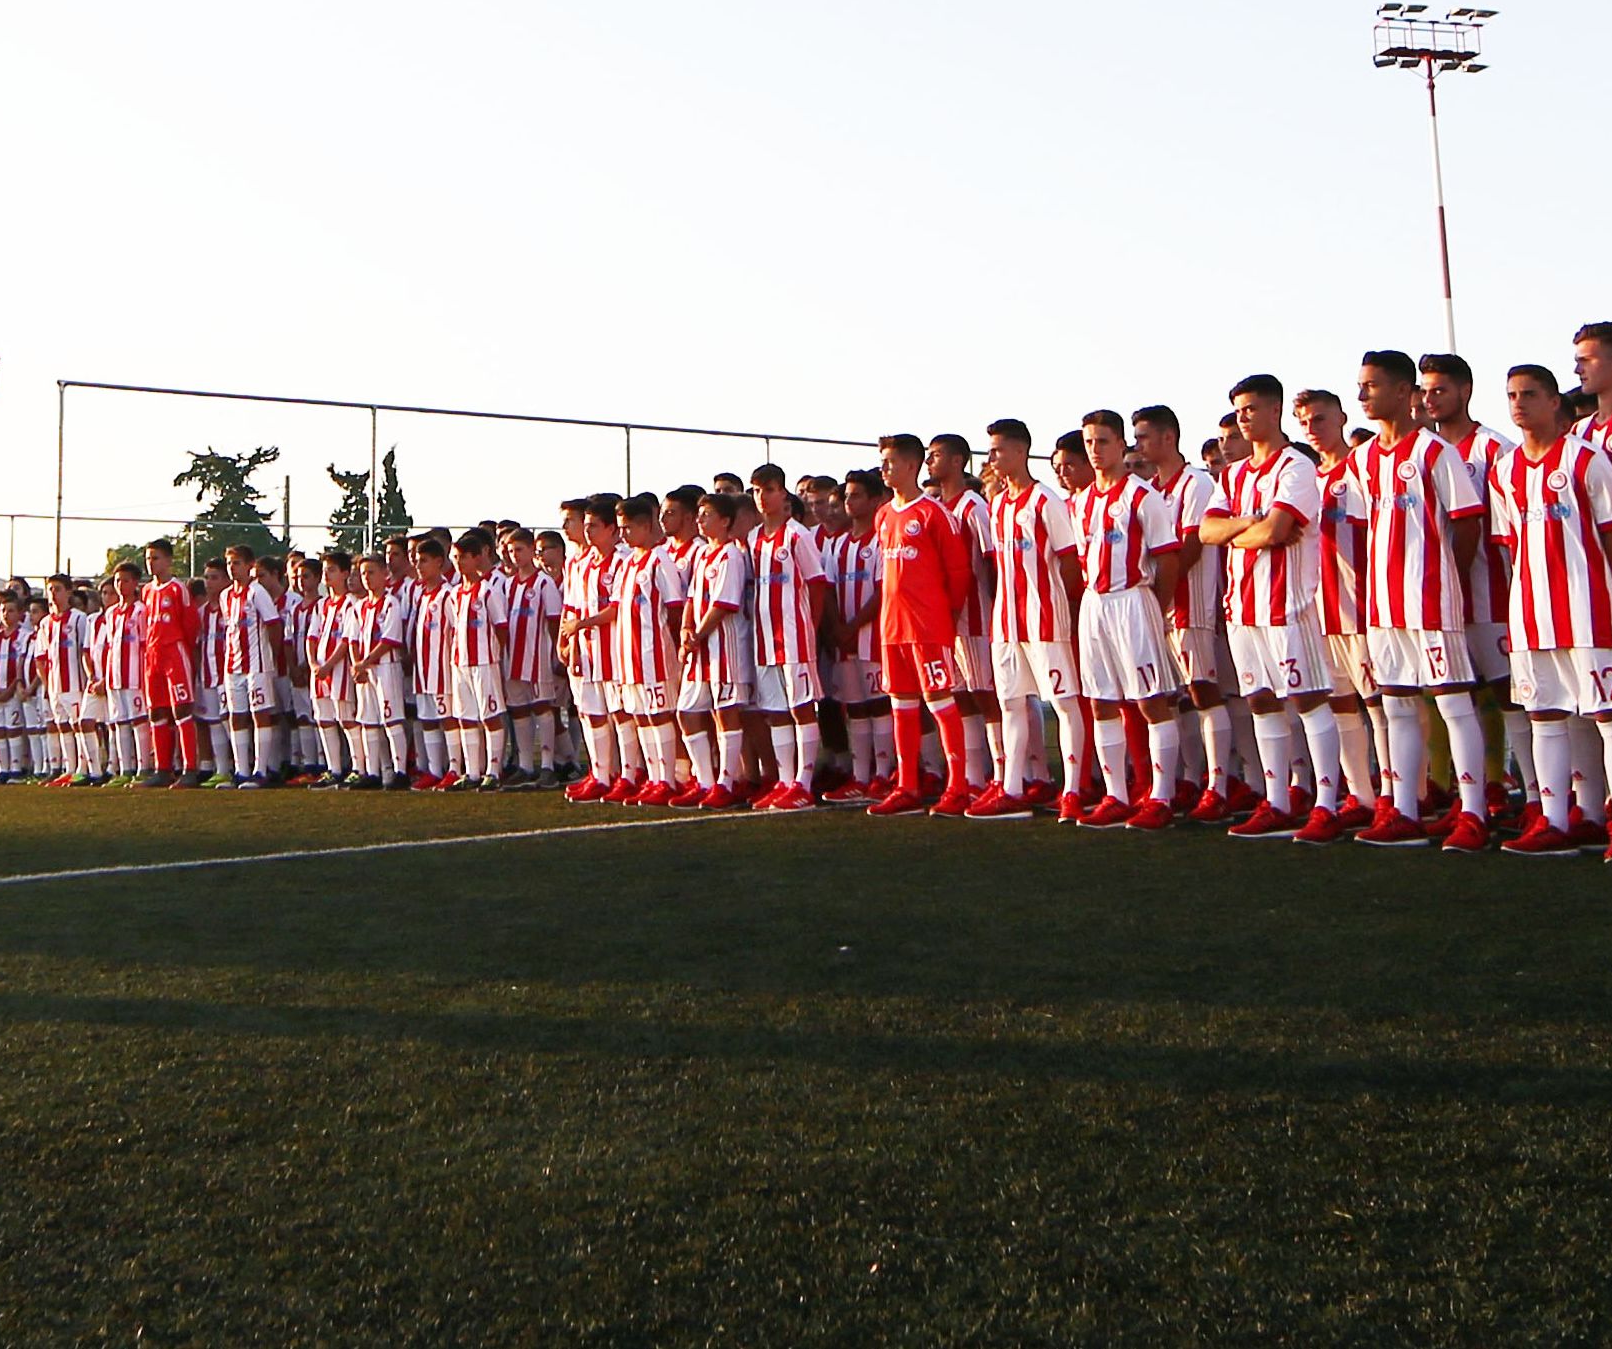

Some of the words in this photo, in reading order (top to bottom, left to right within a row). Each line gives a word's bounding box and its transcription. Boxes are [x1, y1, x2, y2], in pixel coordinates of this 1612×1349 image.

[923, 660, 947, 687] 15
[1425, 647, 1448, 679] 13
[799, 672, 809, 696] 7
[1049, 669, 1066, 694] 2
[1137, 663, 1159, 692] 11
[172, 683, 188, 702] 15
[134, 697, 143, 713] 9
[437, 697, 447, 715] 3
[488, 695, 497, 713] 6
[11, 711, 21, 726] 2
